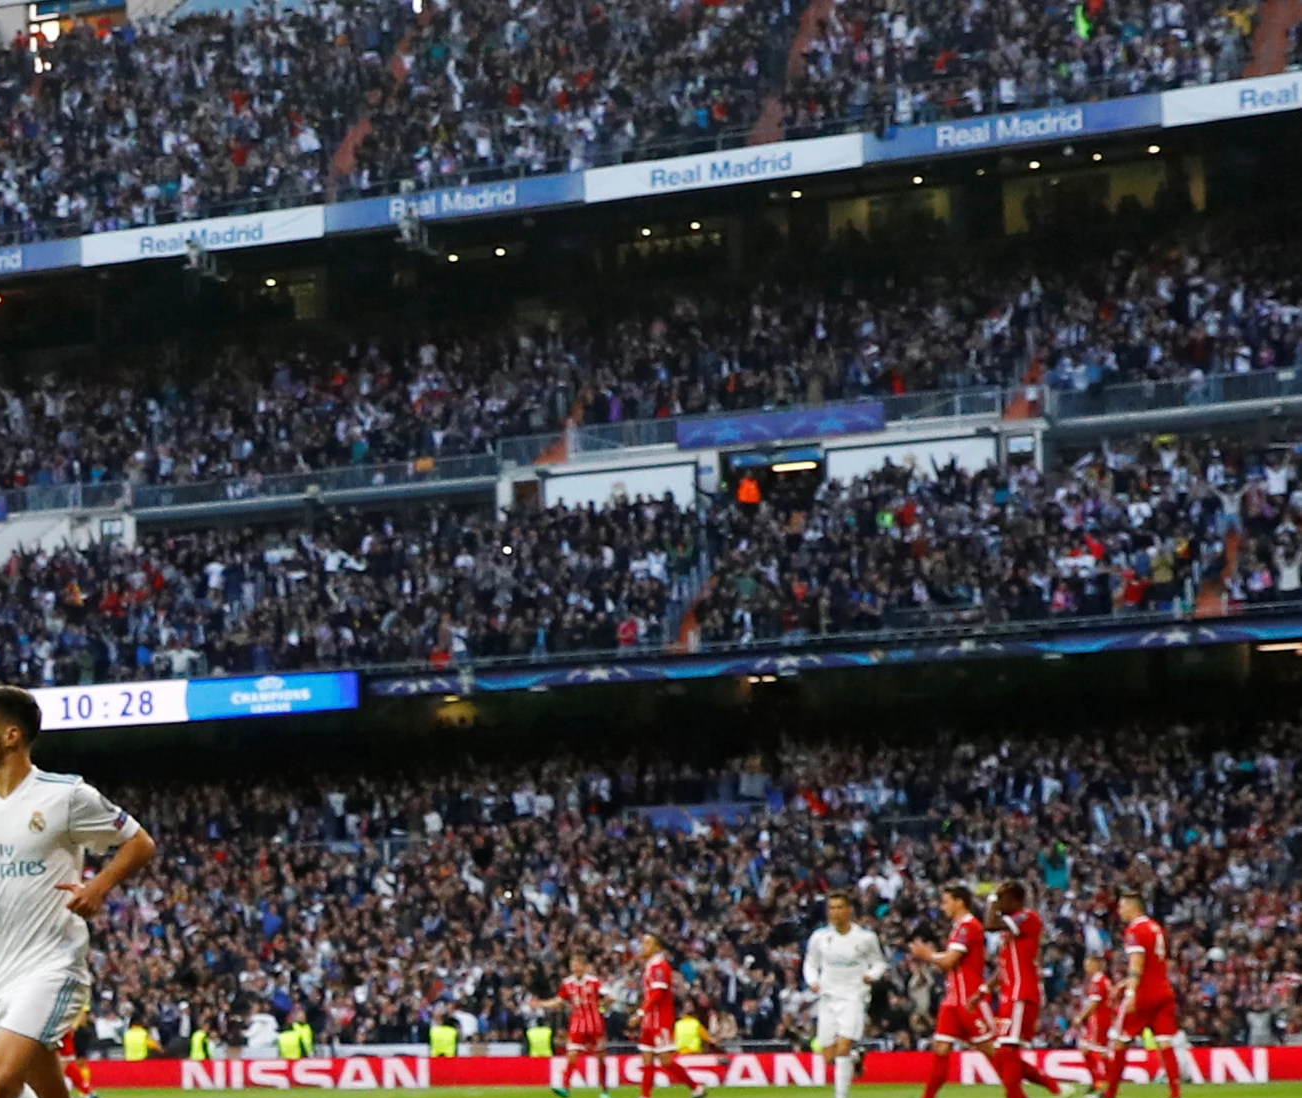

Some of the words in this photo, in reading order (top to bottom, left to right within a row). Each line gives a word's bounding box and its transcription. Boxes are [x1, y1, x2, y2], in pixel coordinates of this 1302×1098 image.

[1240, 82, 1299, 111] Real
[936, 123, 989, 147] Real
[994, 108, 1083, 139] Madrid
[650, 165, 701, 188] Real
[709, 151, 792, 182] Madrid
[441, 184, 517, 214] Madrid
[191, 223, 265, 247] Madrid
[182, 1057, 430, 1089] NISSAN
